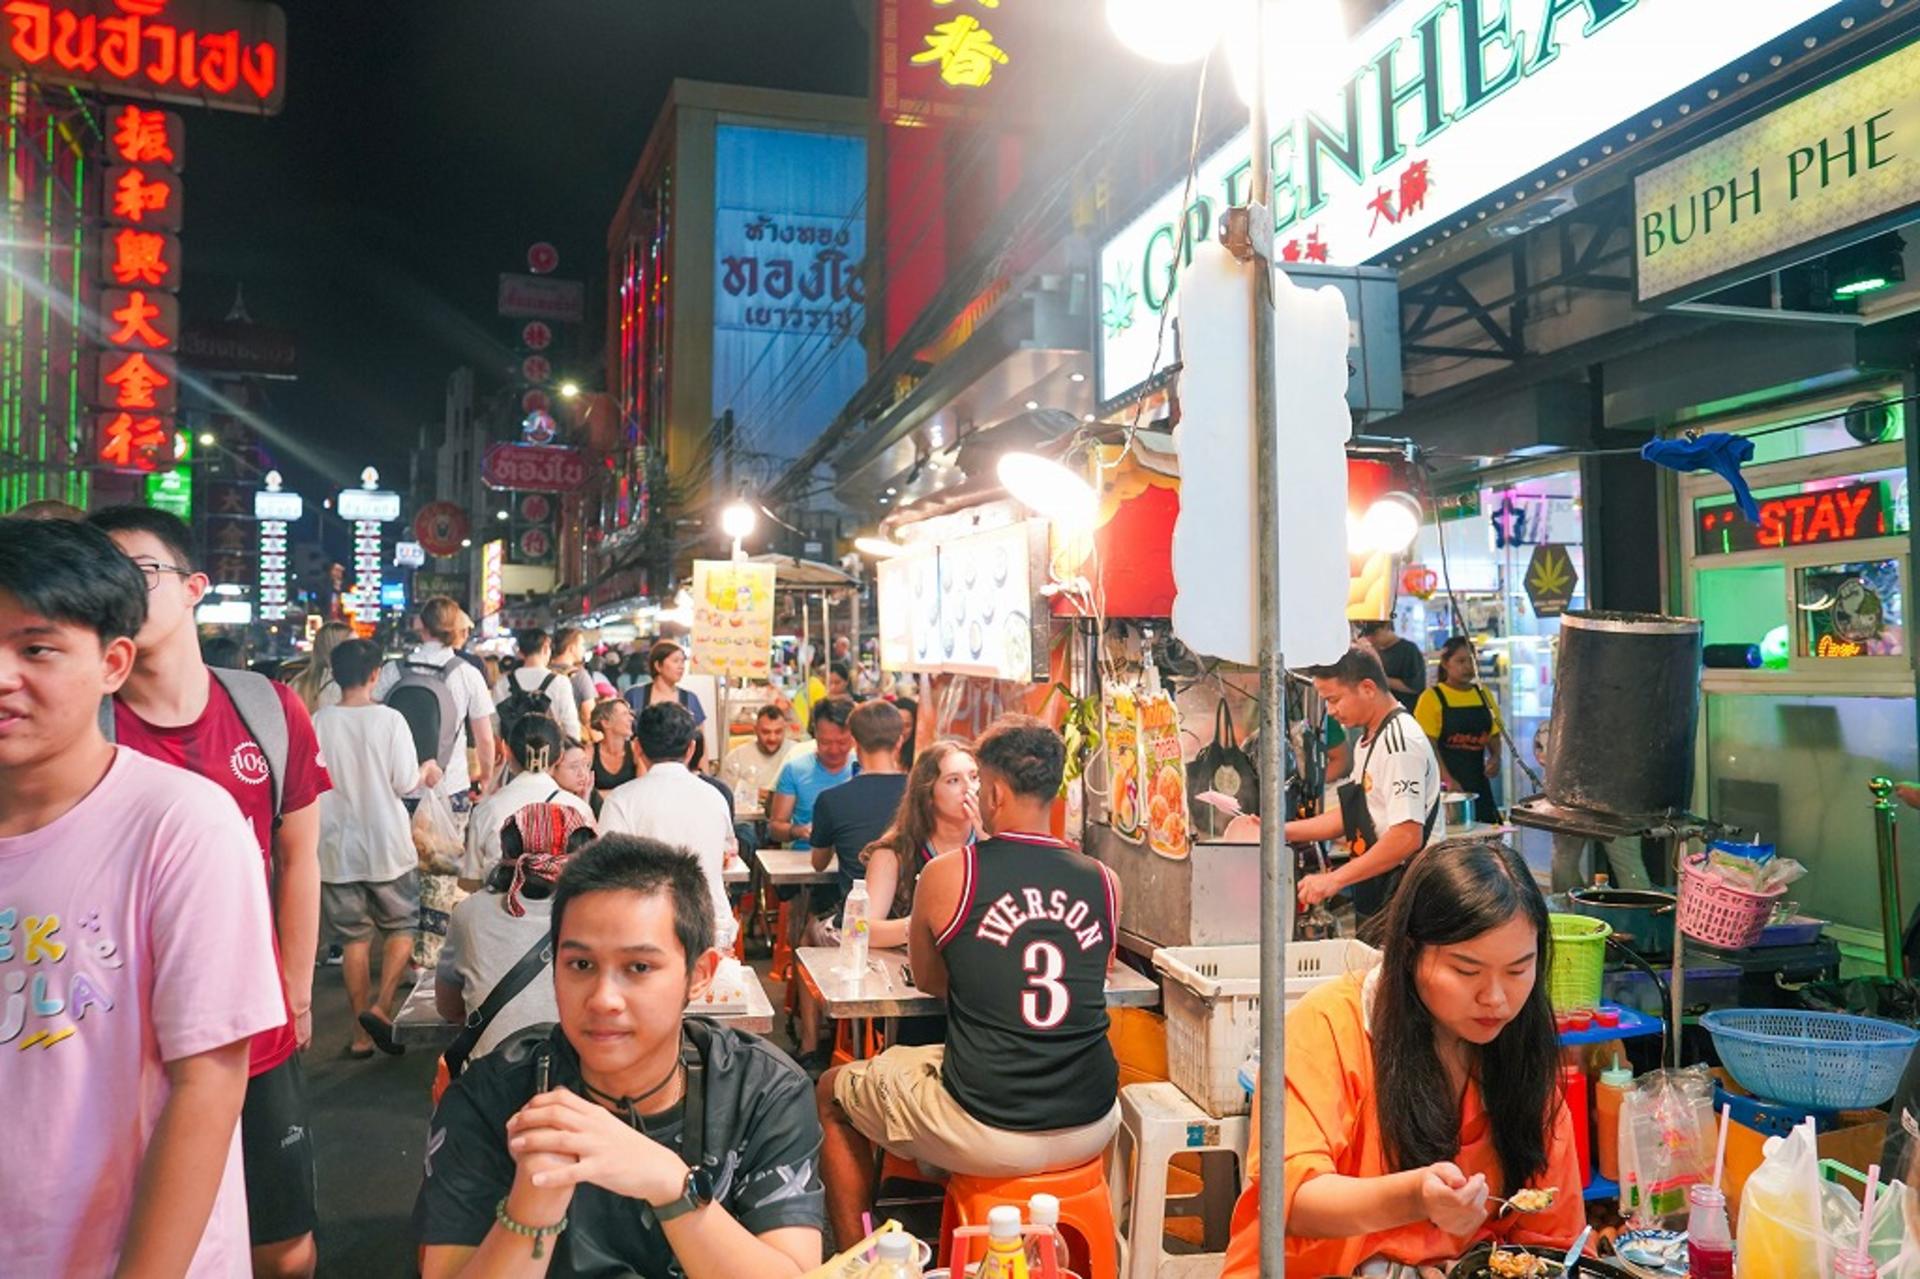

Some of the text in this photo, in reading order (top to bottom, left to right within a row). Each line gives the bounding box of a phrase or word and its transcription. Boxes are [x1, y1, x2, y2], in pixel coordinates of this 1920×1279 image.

[1642, 108, 1899, 258] BUPH PHE
[102, 104, 174, 471] 振和興大金行
[1757, 487, 1872, 546] STAY
[976, 886, 1104, 951] IVERSON
[1020, 939, 1071, 1032] 3
